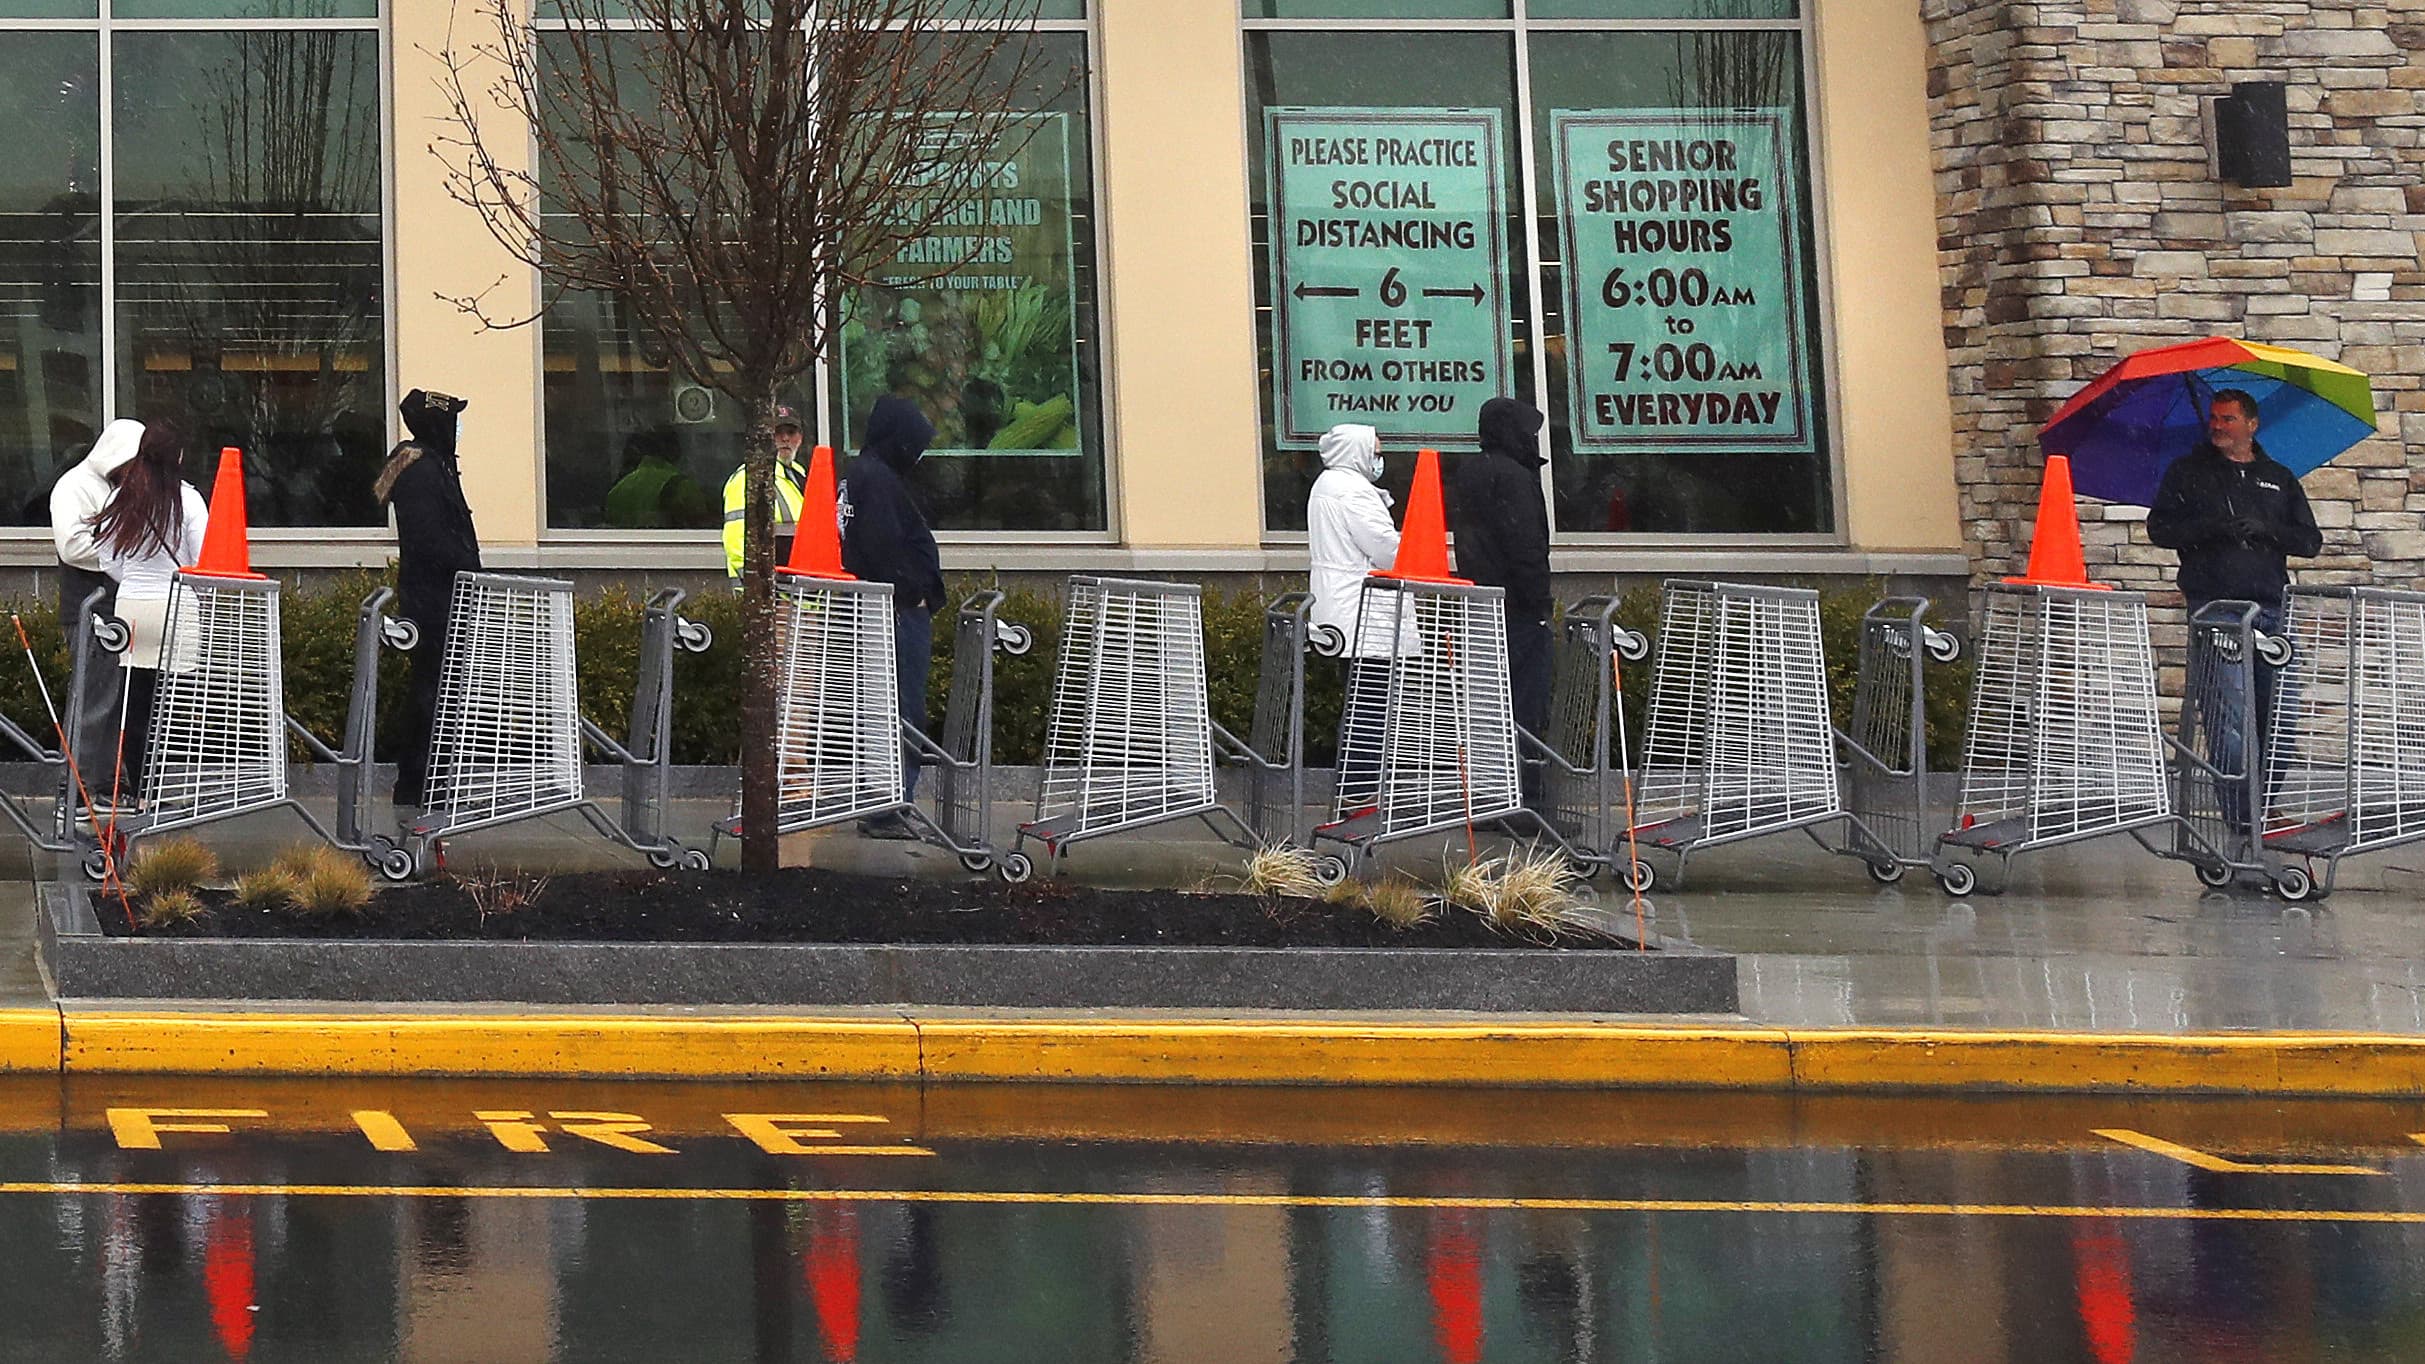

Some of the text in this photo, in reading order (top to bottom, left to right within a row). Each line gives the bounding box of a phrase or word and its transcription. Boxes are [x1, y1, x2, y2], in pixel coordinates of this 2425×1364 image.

[1291, 138, 1478, 167] PLEASE PRACTICE
[1607, 139, 1737, 173] SENIOR
[1331, 180, 1436, 210] SOCIAL
[1584, 178, 1763, 213] SHOPPING
[896, 235, 1014, 264] FARMERS
[1297, 220, 1475, 250] DISTANCING
[1615, 219, 1733, 254] HOURS
[946, 276, 979, 290] YOUR
[1379, 266, 1408, 308] 6
[1356, 319, 1432, 348] FEET
[1665, 314, 1695, 335] to
[1301, 360, 1485, 382] FROM OTHERS
[1327, 393, 1455, 412] THANK YOU
[1595, 391, 1781, 426] EVERYDAY
[104, 1107, 938, 1157] FIRE
